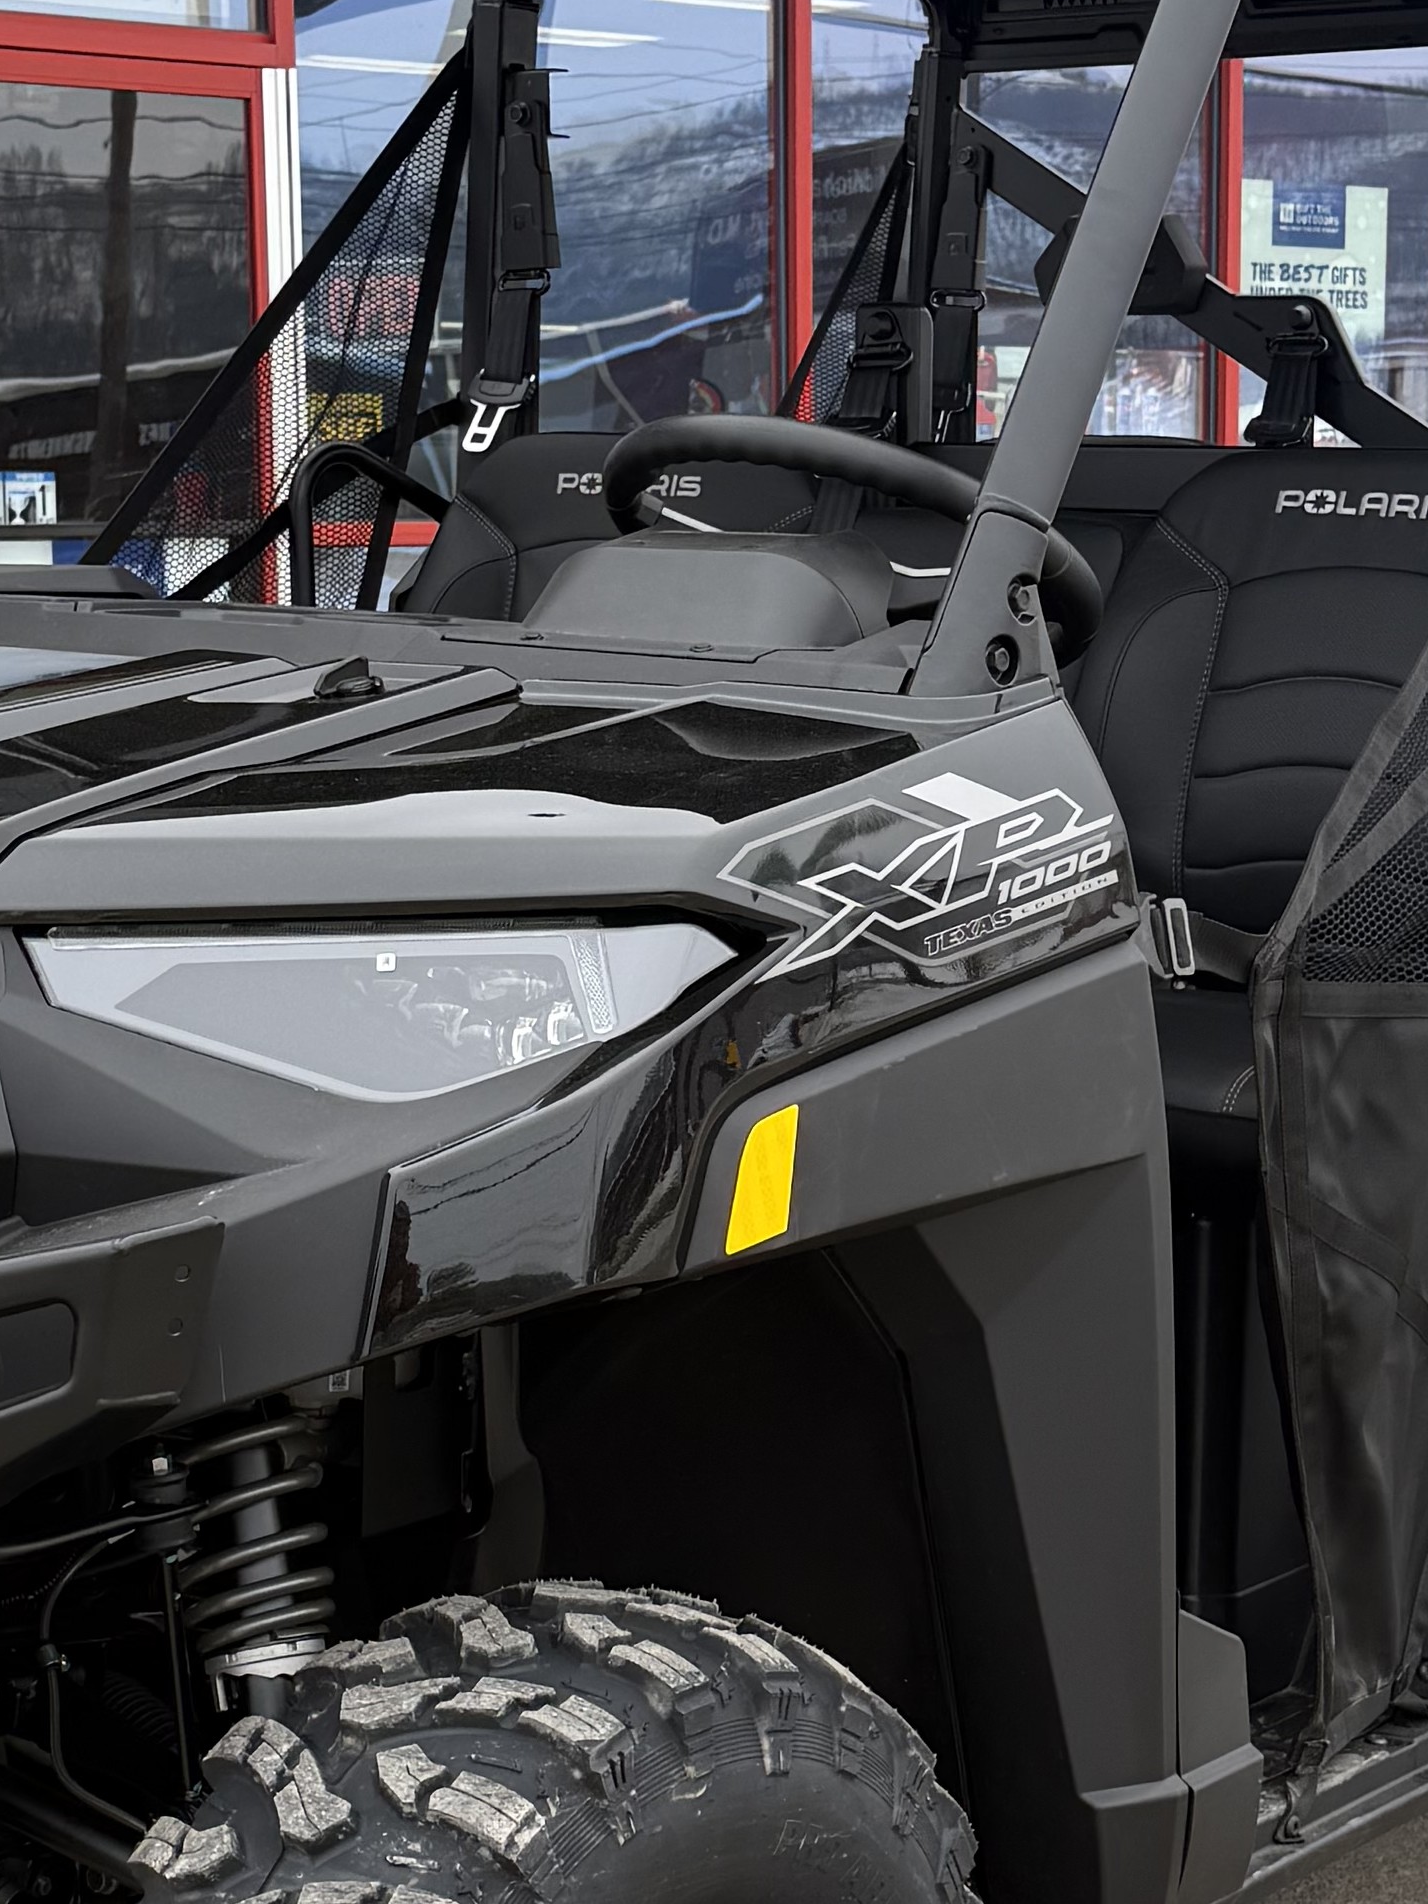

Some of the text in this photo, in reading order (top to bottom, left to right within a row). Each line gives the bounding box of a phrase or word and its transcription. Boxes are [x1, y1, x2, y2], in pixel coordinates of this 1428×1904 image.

[1251, 262, 1367, 286] THE BEST GIFTS
[1328, 289, 1368, 309] TREES
[997, 840, 1112, 906] 1000
[923, 876, 1109, 957] TEXAS EDITION
